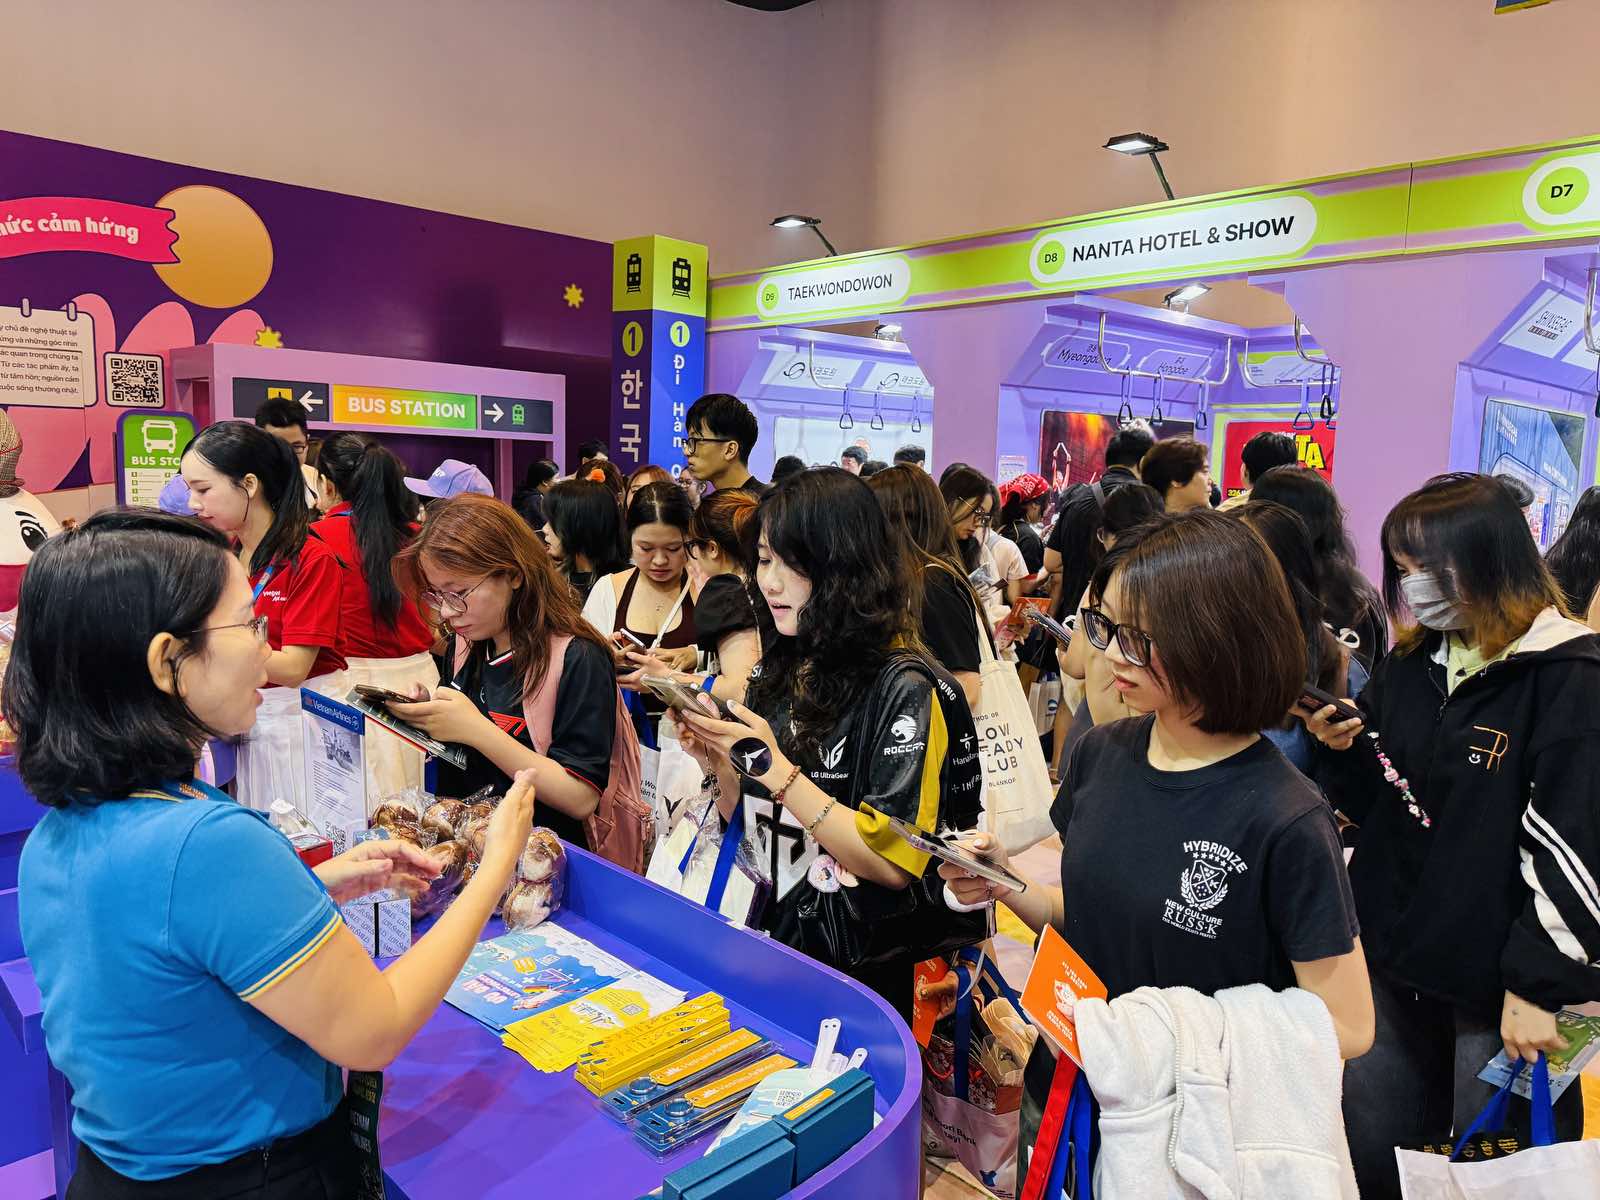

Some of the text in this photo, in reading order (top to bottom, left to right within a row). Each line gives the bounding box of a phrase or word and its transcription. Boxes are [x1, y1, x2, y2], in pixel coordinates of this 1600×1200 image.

[1550, 183, 1574, 199] D7
[38, 212, 82, 232] cảm
[85, 216, 139, 244] hứng
[1044, 216, 1295, 264] D8 NANTA HOTEL & SHOW
[788, 273, 893, 301] TAEKWONDOWON
[676, 325, 684, 343] 1
[673, 355, 685, 385] Đi
[1057, 348, 1112, 365] Myeongdng
[348, 396, 466, 420] BUS STATION
[619, 326, 644, 463] 1 한국
[673, 401, 685, 448] Hàn
[131, 456, 181, 466] BUS STO
[883, 741, 925, 756] ROCCAT
[820, 771, 849, 779] UltraGear
[1183, 840, 1249, 874] HYBRIDIZE
[1165, 898, 1223, 926] NEW CULTURE
